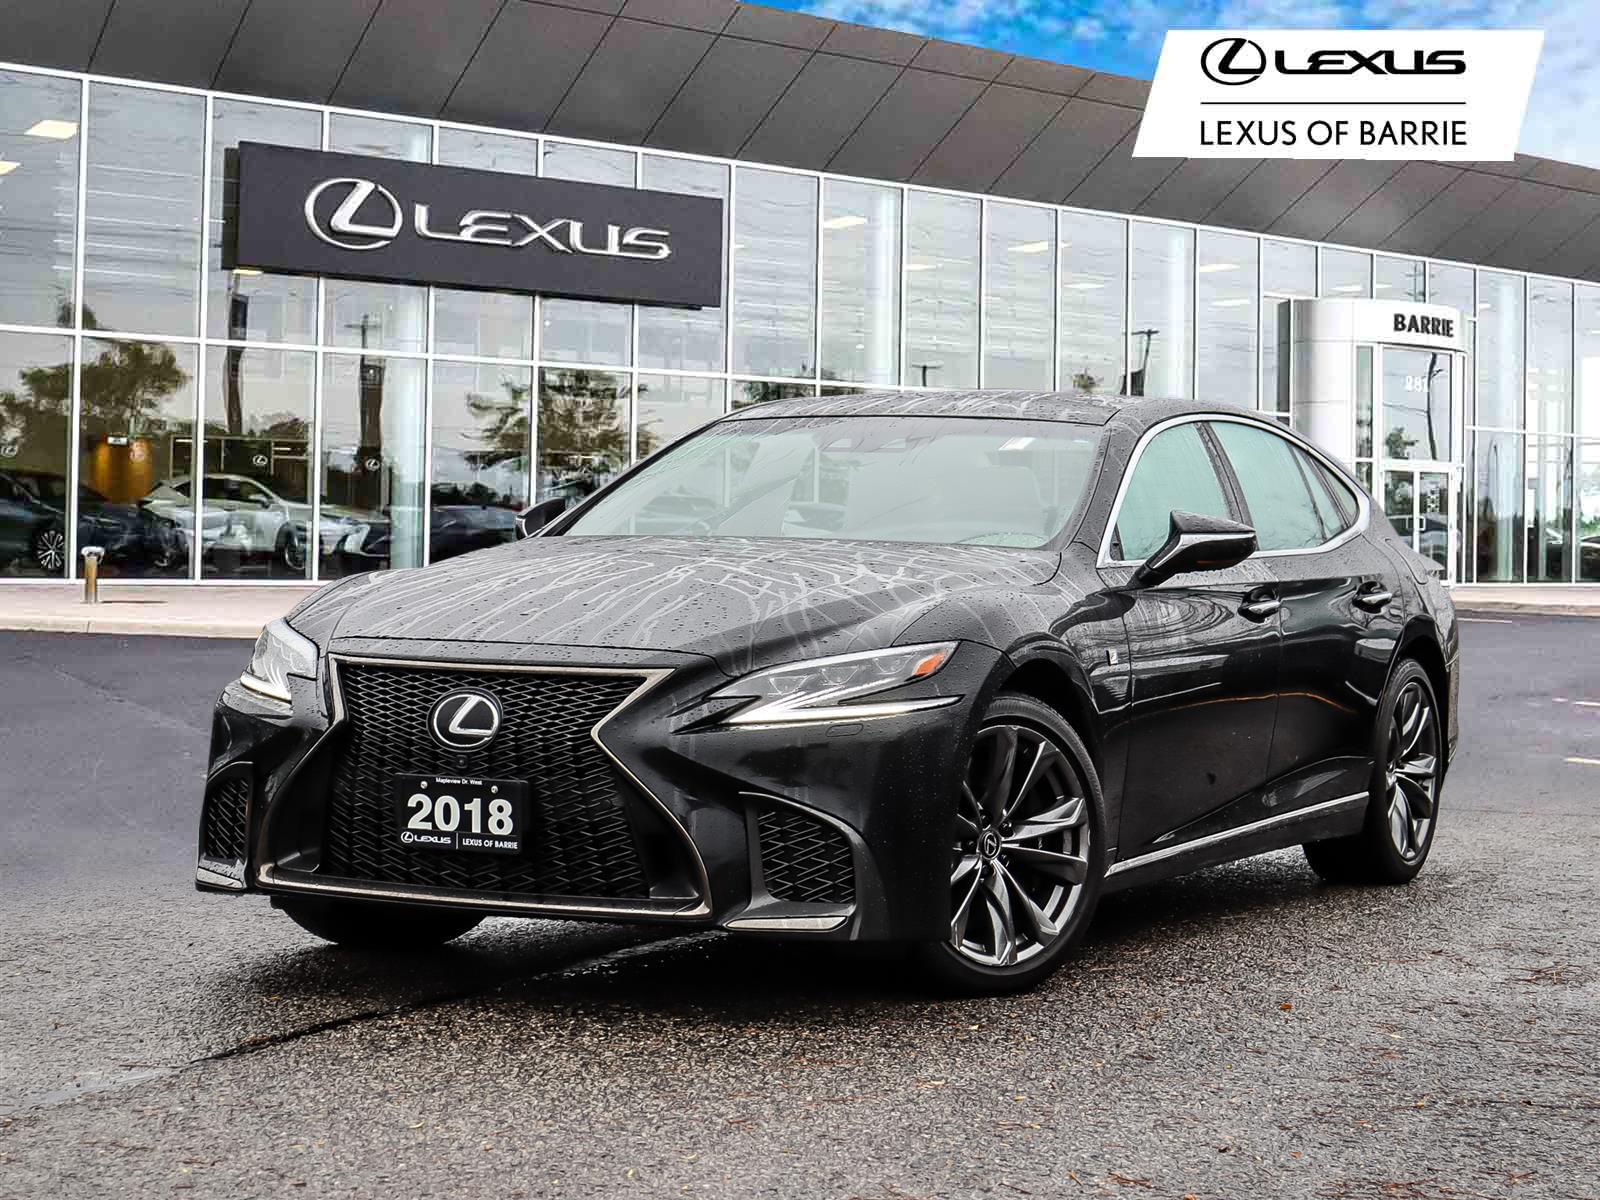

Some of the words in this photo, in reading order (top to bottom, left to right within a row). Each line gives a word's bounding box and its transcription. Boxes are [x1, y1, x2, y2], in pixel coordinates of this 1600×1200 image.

[414, 203, 672, 260] LEXUS
[1393, 313, 1454, 338] BARRIE
[407, 793, 514, 836] 2018
[414, 834, 452, 844] LEXUS
[462, 838, 482, 847] LEXUS
[483, 839, 494, 848] OF
[494, 840, 518, 850] BARRIE
